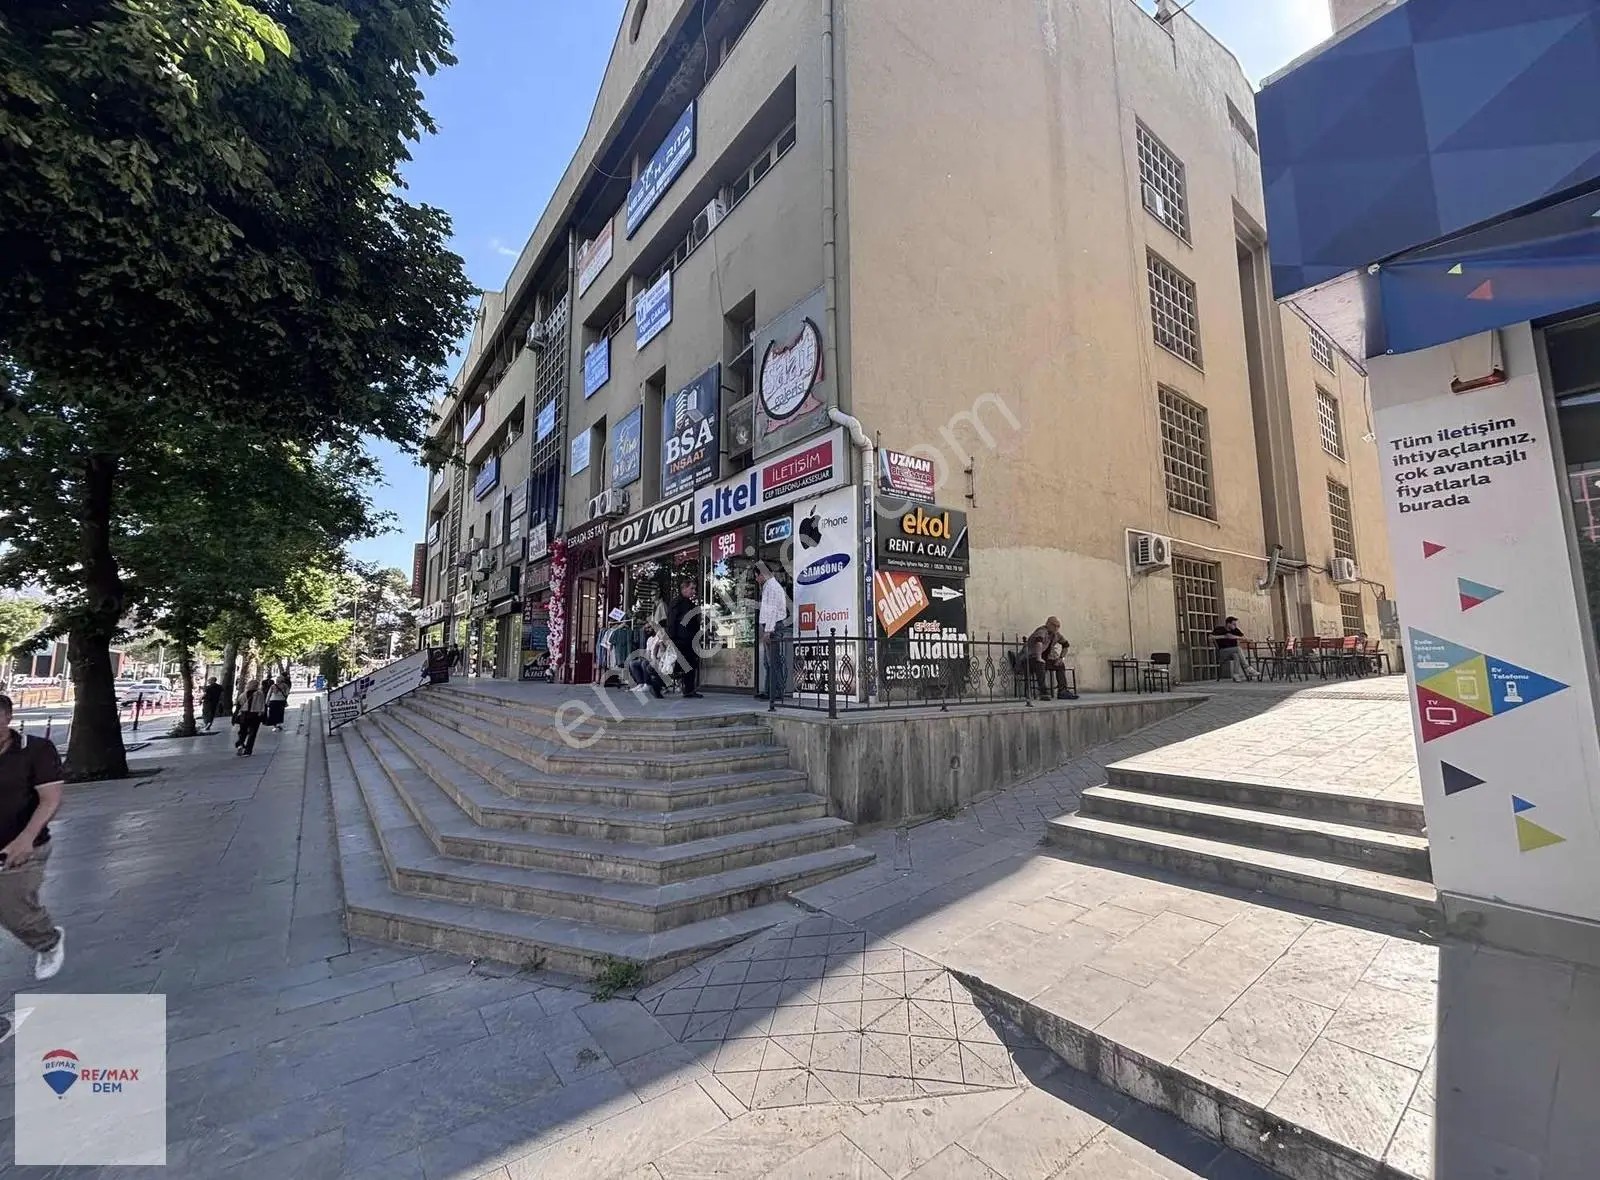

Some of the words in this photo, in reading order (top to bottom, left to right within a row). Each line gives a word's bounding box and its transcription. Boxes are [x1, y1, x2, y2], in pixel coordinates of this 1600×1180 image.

[665, 420, 714, 464] BSA
[1391, 434, 1433, 451] Tüm
[1438, 417, 1516, 441] iletişim
[1392, 432, 1536, 467] ihtiyaçlarınız,
[890, 452, 931, 473] UZMAN
[1394, 465, 1428, 484] çok
[1433, 449, 1527, 476] avantajlı
[700, 472, 757, 524] altel
[1396, 473, 1491, 498] fiyatlarla
[1399, 495, 1471, 513] burada
[608, 519, 644, 550] BOY
[652, 500, 693, 534] KOT
[903, 507, 951, 539] ekol
[718, 532, 736, 549] gen
[722, 543, 736, 558] pa
[889, 539, 915, 553] RENT
[917, 541, 925, 554] A
[927, 543, 947, 557] CAR
[803, 561, 844, 577] SAMSUNG
[875, 570, 924, 626] akbaş
[816, 607, 849, 622] Xiaomi
[795, 646, 809, 656] CEP
[812, 645, 853, 656] TELEONU
